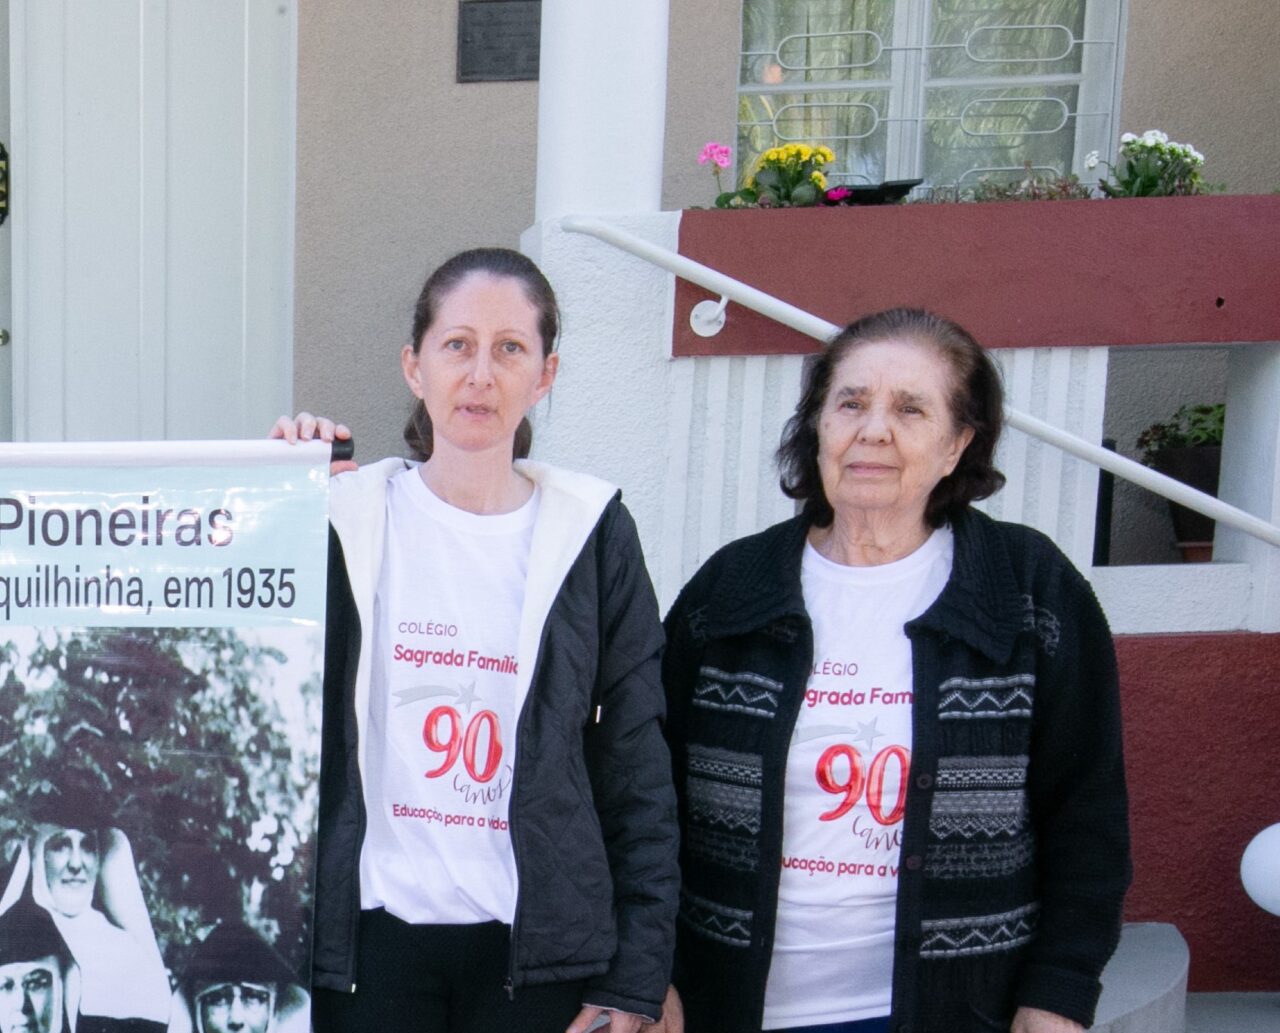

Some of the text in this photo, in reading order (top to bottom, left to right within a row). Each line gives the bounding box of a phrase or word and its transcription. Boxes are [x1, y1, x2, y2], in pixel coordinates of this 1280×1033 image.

[163, 576, 215, 608] em
[222, 567, 297, 609] 1935
[398, 620, 458, 637] COLÉGIO
[393, 644, 464, 668] Sagrada
[813, 658, 859, 677] LÉGIO
[804, 687, 866, 708] grada
[422, 705, 503, 783] 90
[815, 743, 912, 826] 90
[392, 804, 508, 831] Educação para a vida
[781, 855, 835, 877] ucação
[837, 862, 875, 878] para
[877, 865, 888, 878] a
